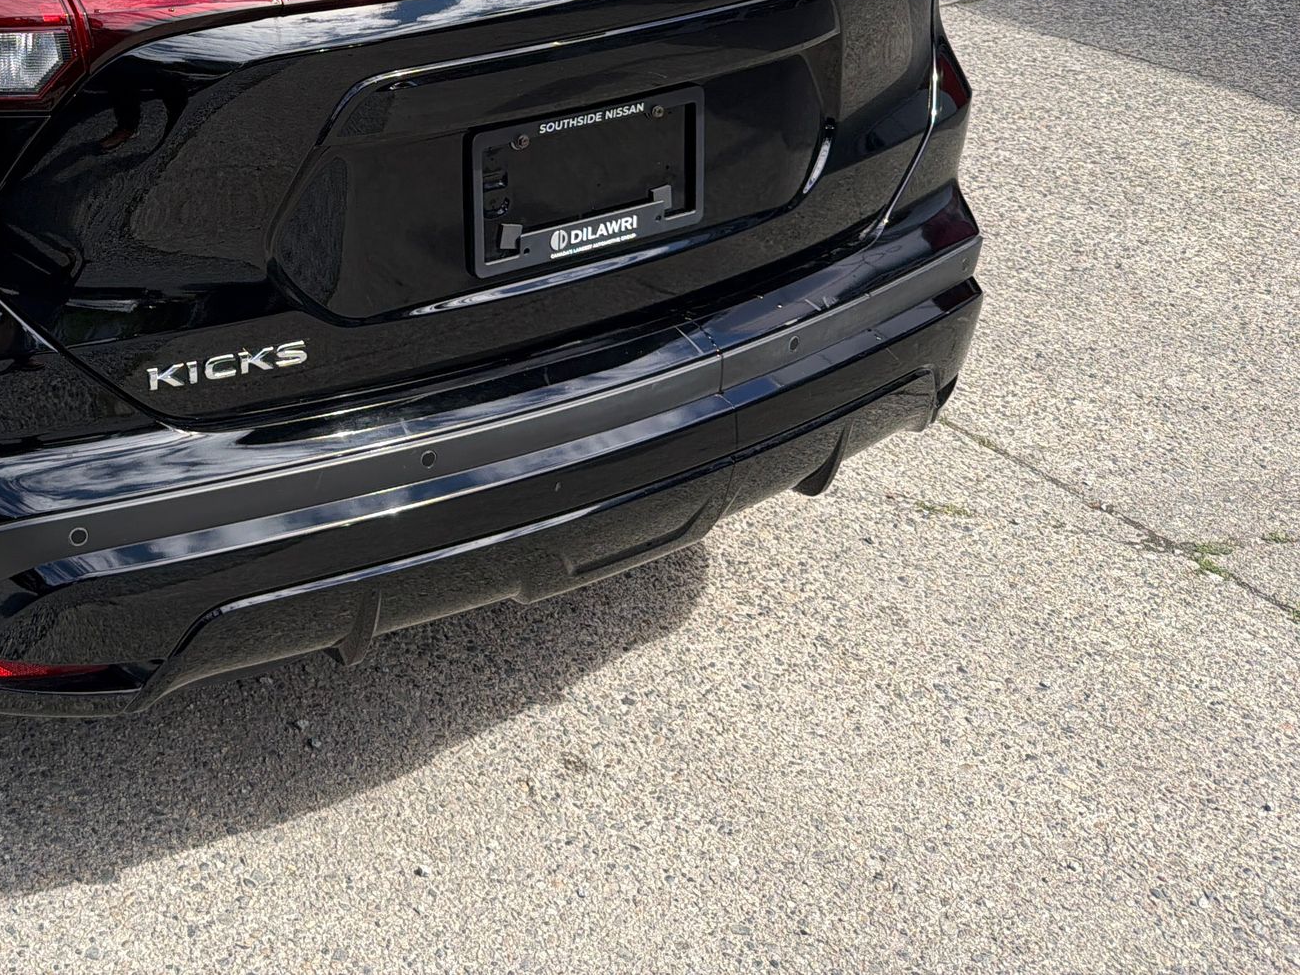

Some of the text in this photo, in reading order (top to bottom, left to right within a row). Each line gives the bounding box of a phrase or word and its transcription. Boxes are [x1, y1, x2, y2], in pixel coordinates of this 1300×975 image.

[539, 102, 645, 134] SOUTHSIDE NISSAN
[570, 214, 638, 245] DILAWRI
[146, 339, 308, 391] KICKS
